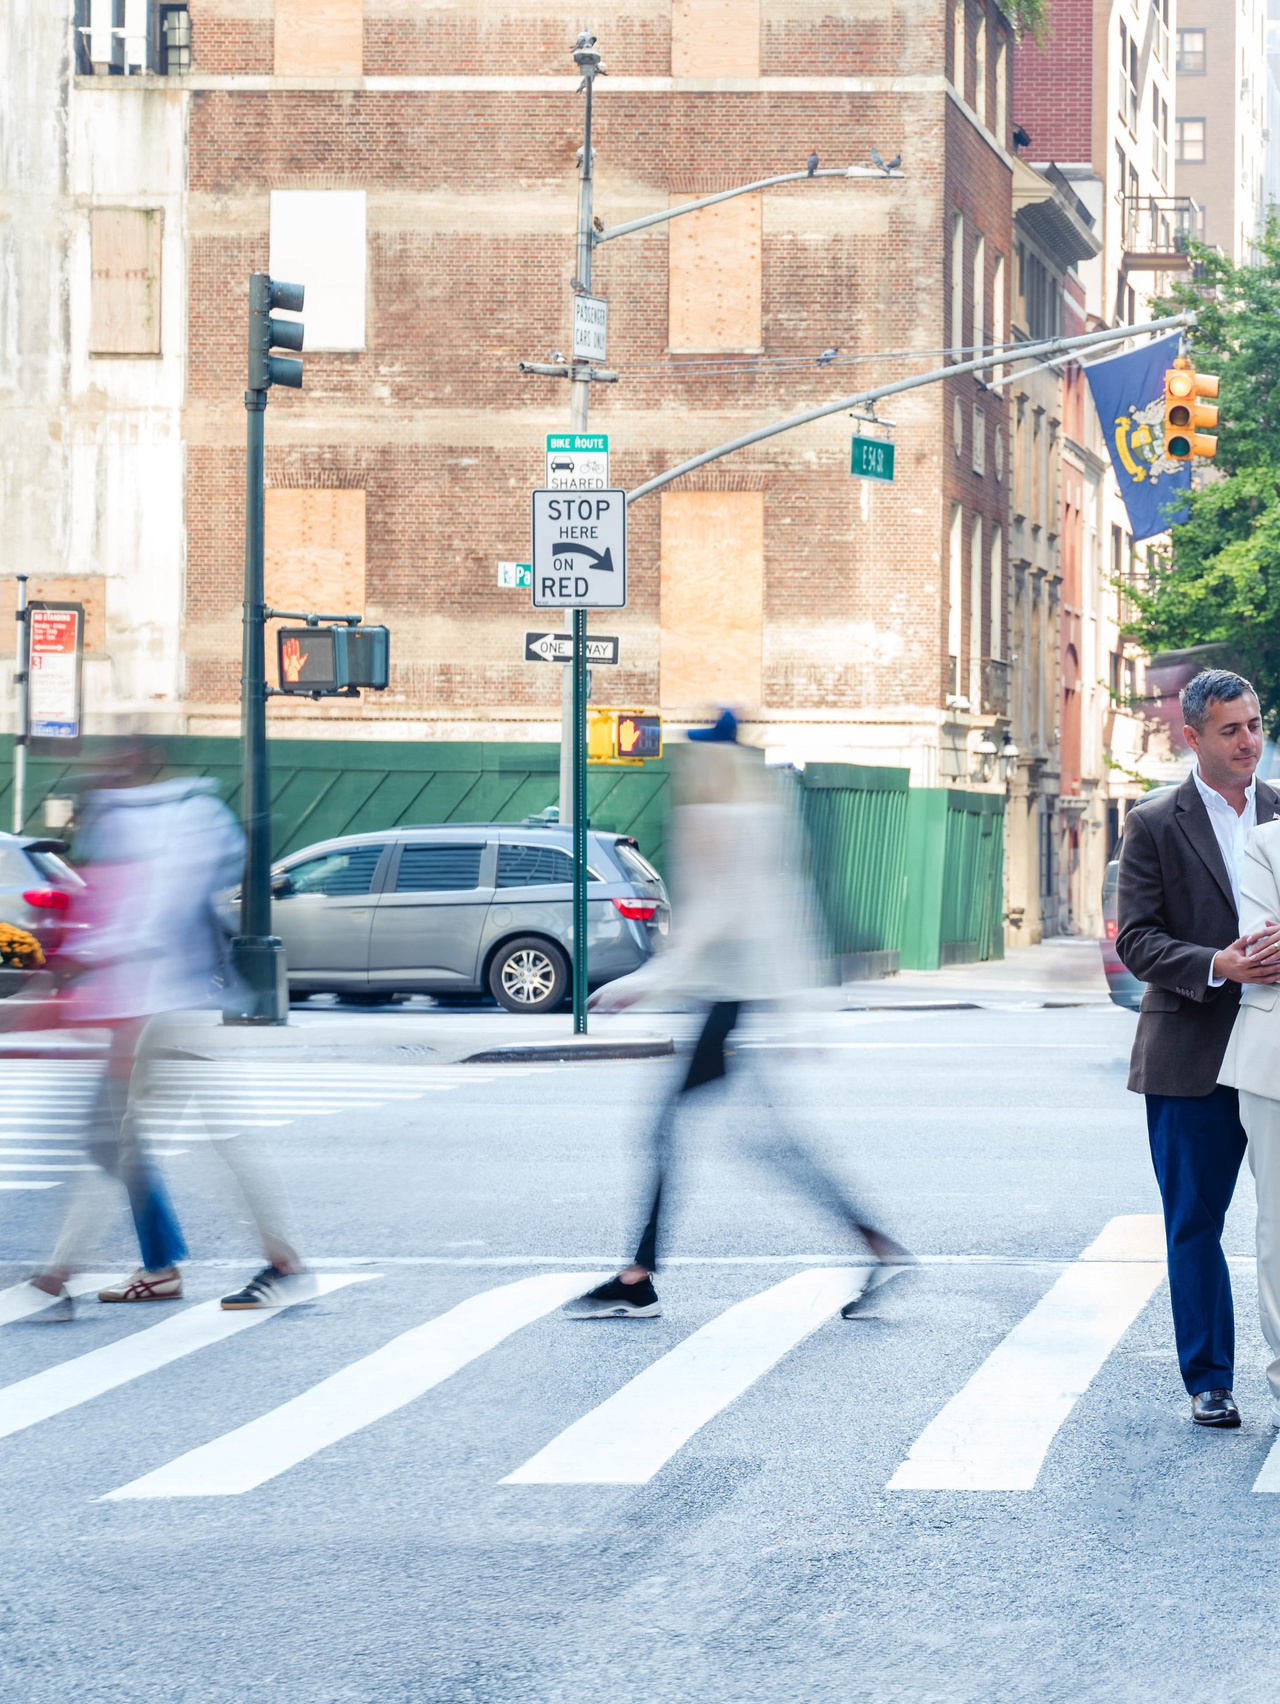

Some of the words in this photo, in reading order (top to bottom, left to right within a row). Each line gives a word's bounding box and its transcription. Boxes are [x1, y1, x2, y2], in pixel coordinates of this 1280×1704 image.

[576, 303, 605, 326] PASSENGER
[576, 328, 591, 347] CARS
[593, 331, 605, 350] ONLY
[550, 438, 571, 449] BIKE
[575, 437, 604, 449] ROUTE
[551, 478, 604, 489] SHARED
[548, 499, 611, 521] STOP
[559, 526, 598, 539] HERE
[553, 558, 573, 571] ON
[542, 577, 589, 597] RED
[540, 641, 565, 655] ONE
[33, 656, 41, 670] 3
